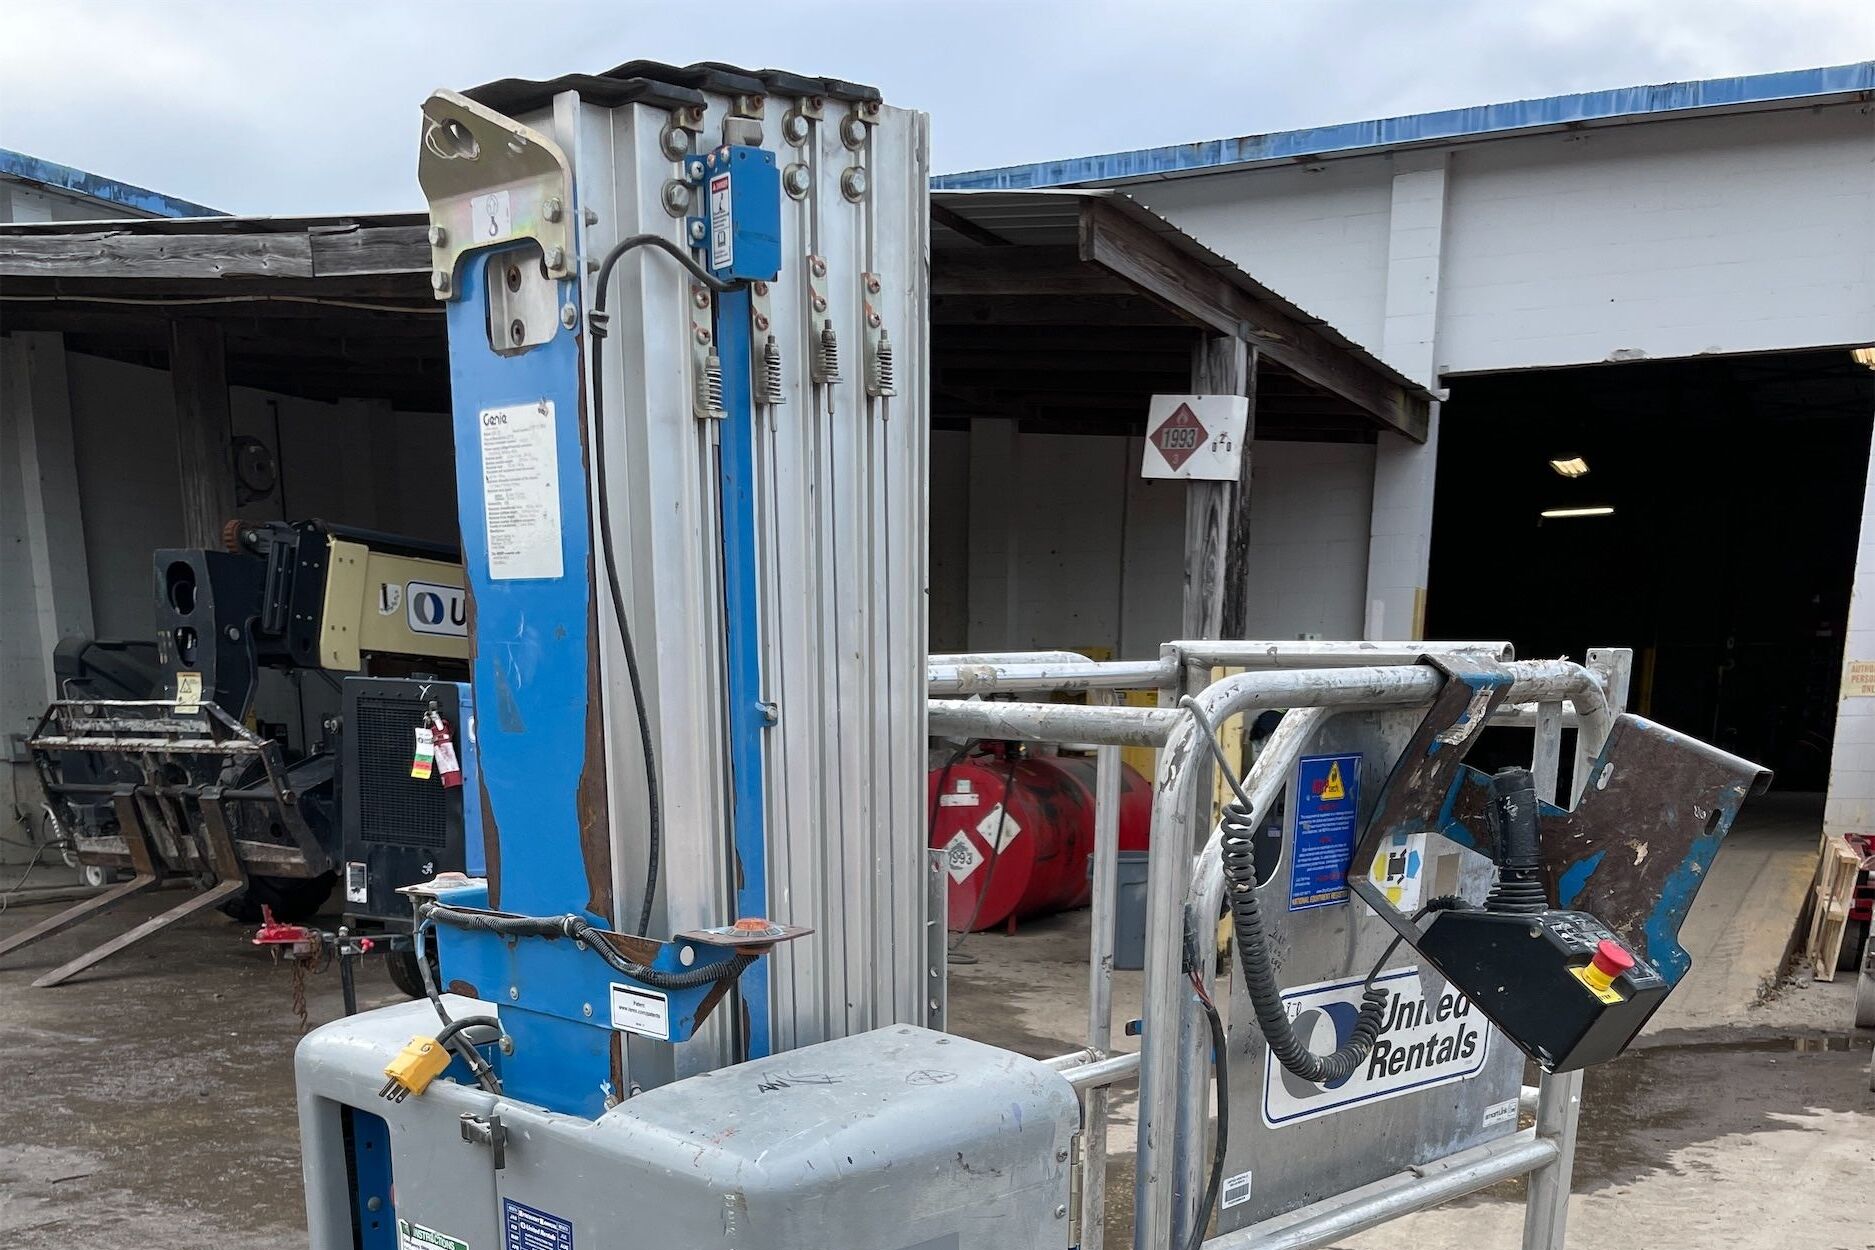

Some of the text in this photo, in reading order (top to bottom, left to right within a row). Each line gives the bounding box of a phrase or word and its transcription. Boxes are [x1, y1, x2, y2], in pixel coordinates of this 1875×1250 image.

[483, 413, 507, 426] Genie
[1164, 429, 1195, 448] 1993
[1378, 992, 1471, 1034] Unied
[1366, 1023, 1477, 1081] Rentals
